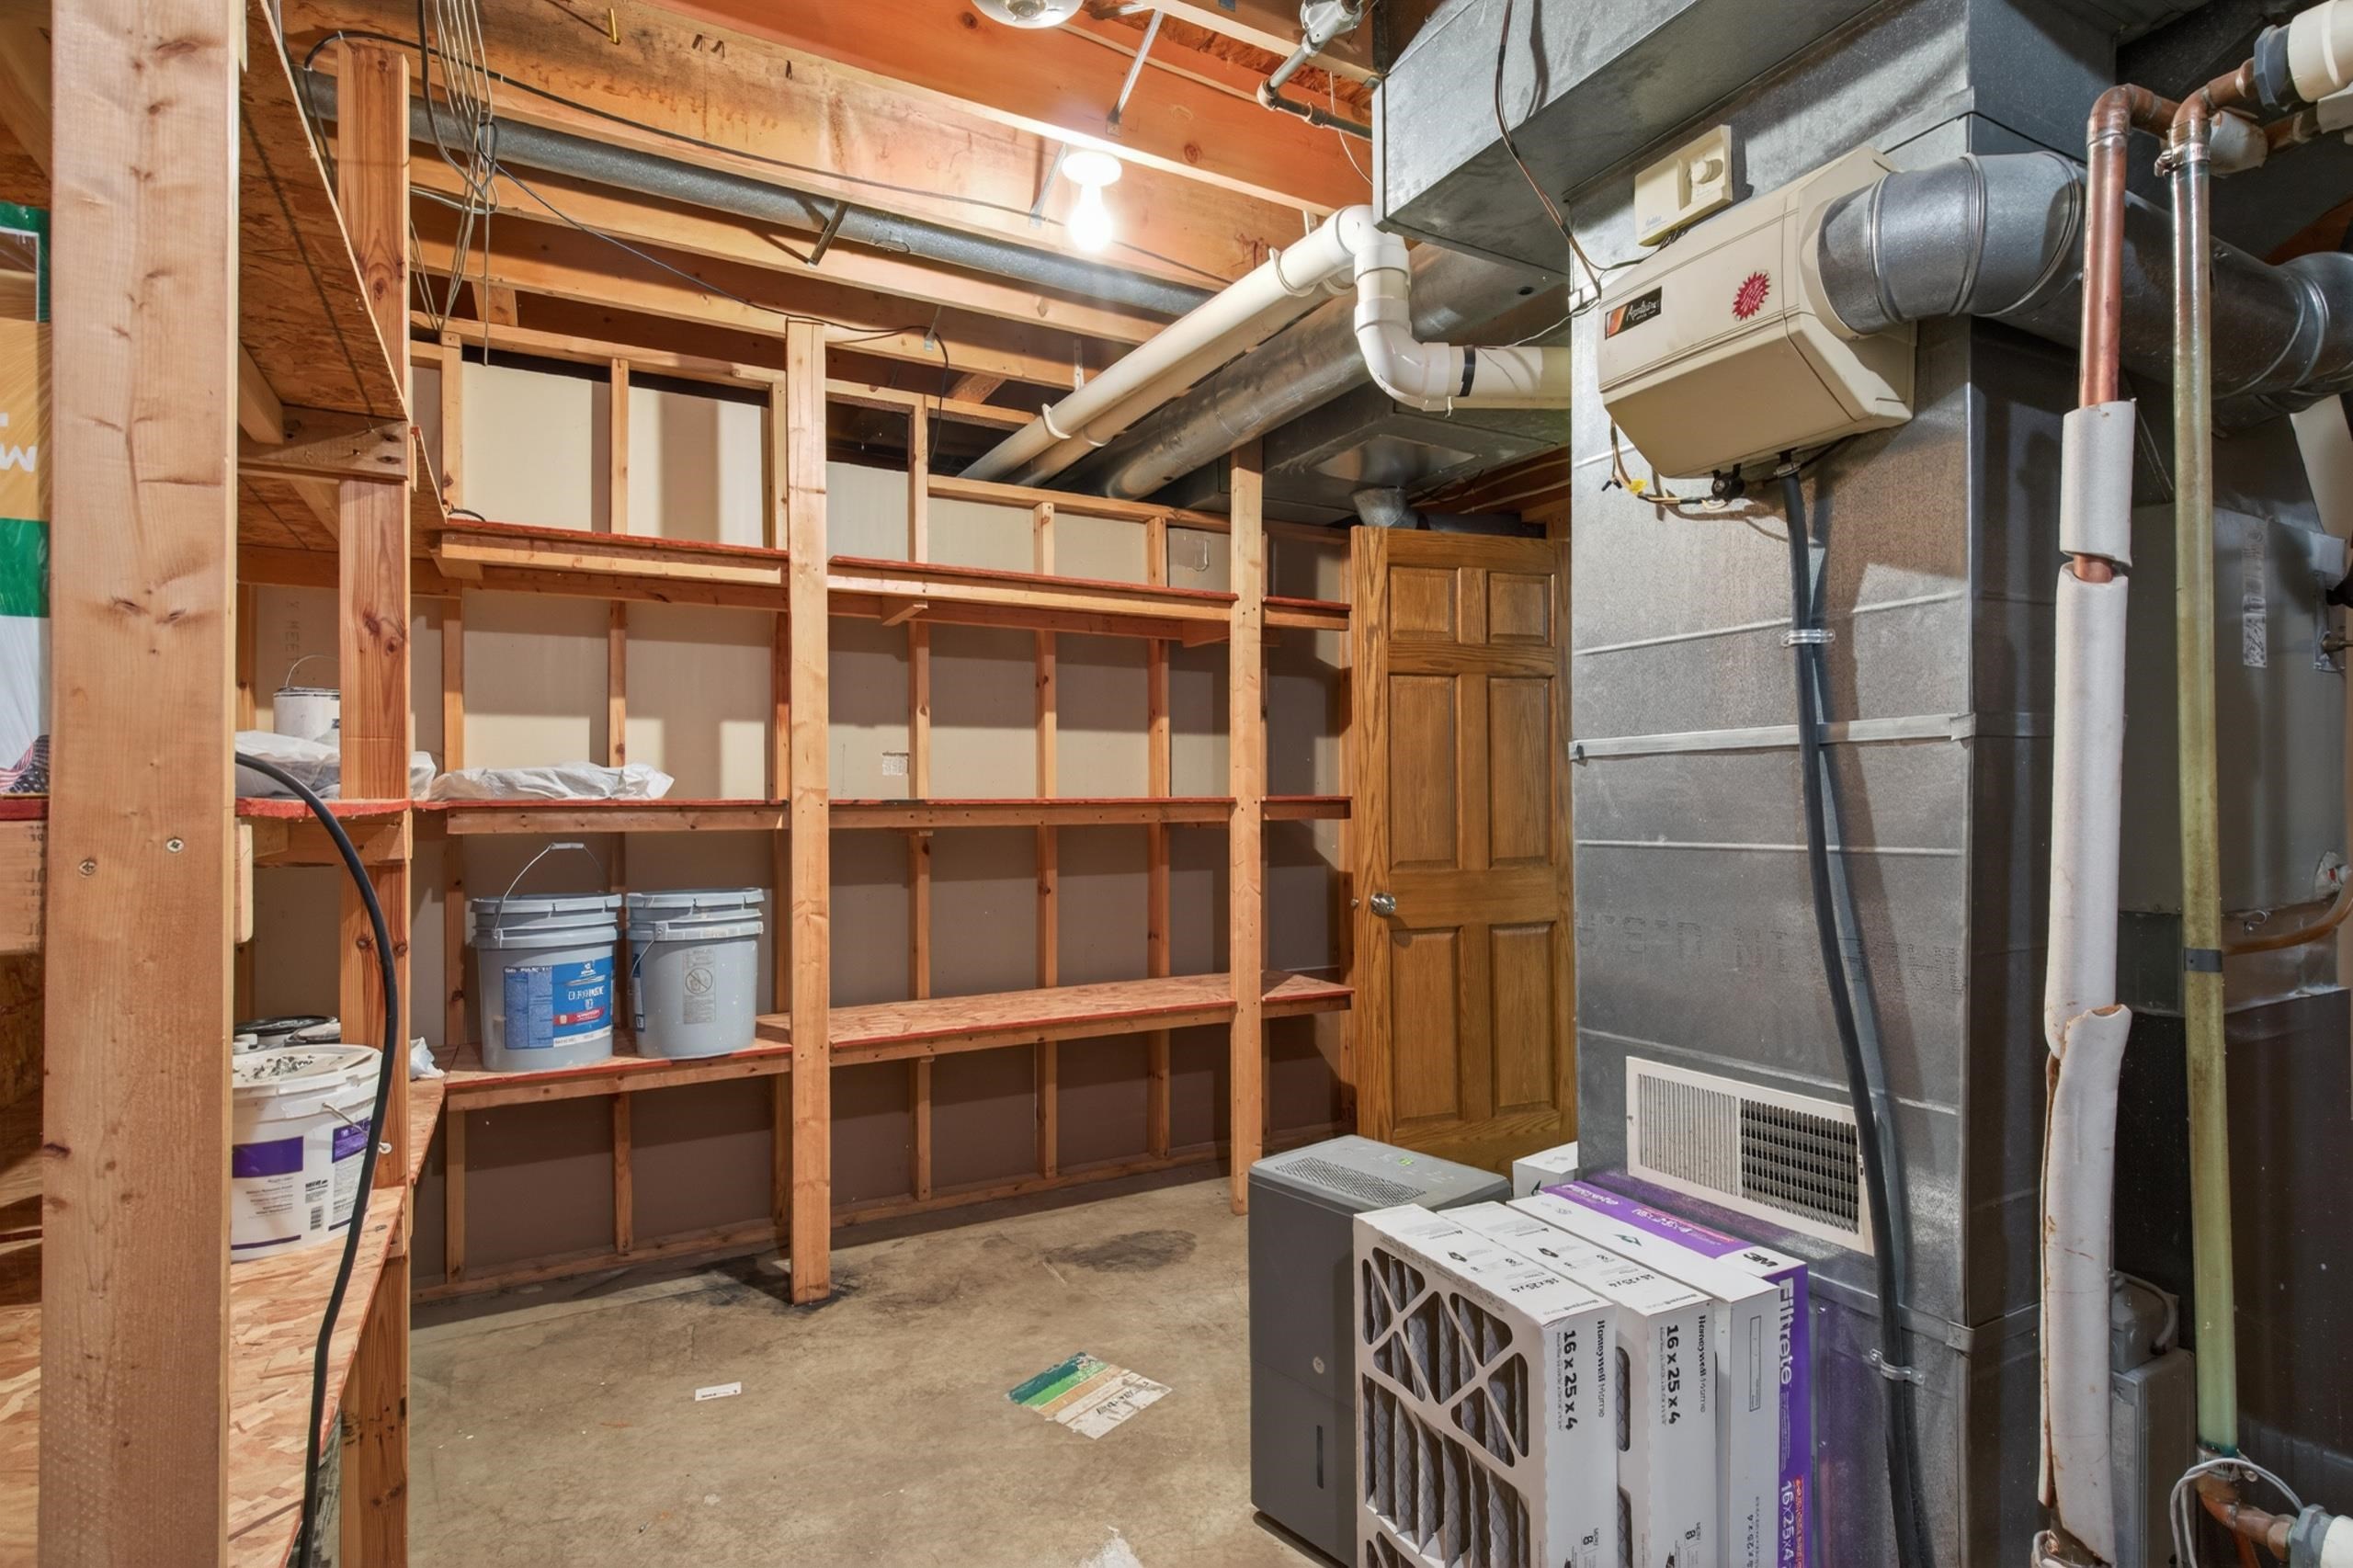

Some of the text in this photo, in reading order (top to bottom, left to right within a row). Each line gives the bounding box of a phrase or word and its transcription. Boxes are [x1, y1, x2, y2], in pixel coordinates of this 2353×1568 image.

[1563, 1330, 1578, 1430] 16 x 25 x 4
[1666, 1324, 1681, 1425] 16 x 25 x 4
[1779, 1277, 1793, 1385] Filtrete
